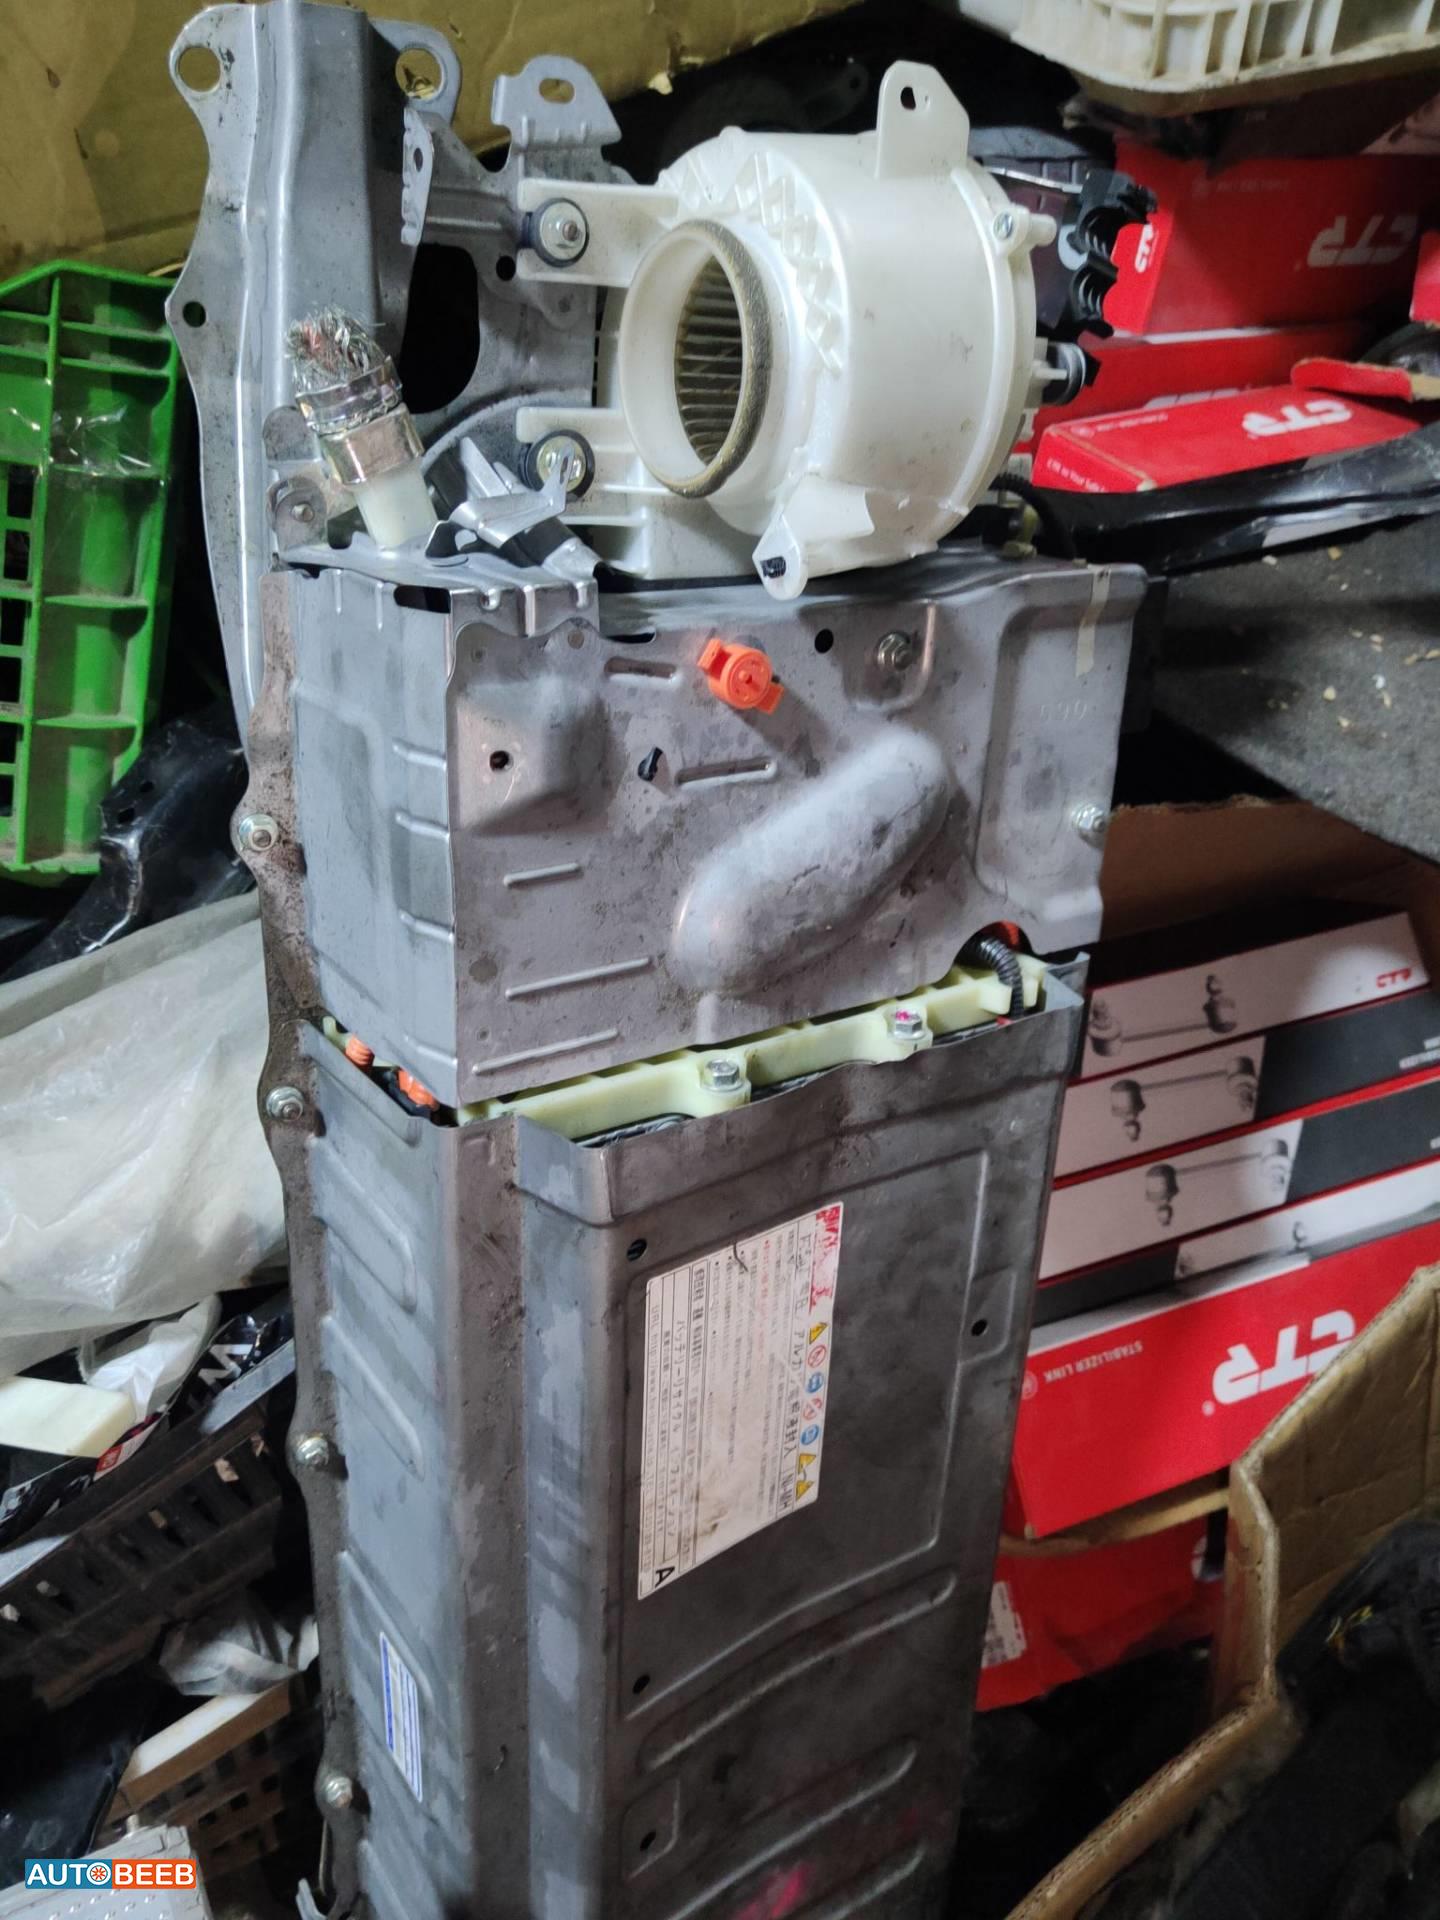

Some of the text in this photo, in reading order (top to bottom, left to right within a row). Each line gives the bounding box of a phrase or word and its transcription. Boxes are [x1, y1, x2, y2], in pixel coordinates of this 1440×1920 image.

[1307, 215, 1418, 268] CTR
[1242, 400, 1352, 437] CTR
[1044, 1341, 1143, 1384] STABILIZER LINK
[1212, 1310, 1356, 1405] CTR
[655, 1566, 675, 1588] A
